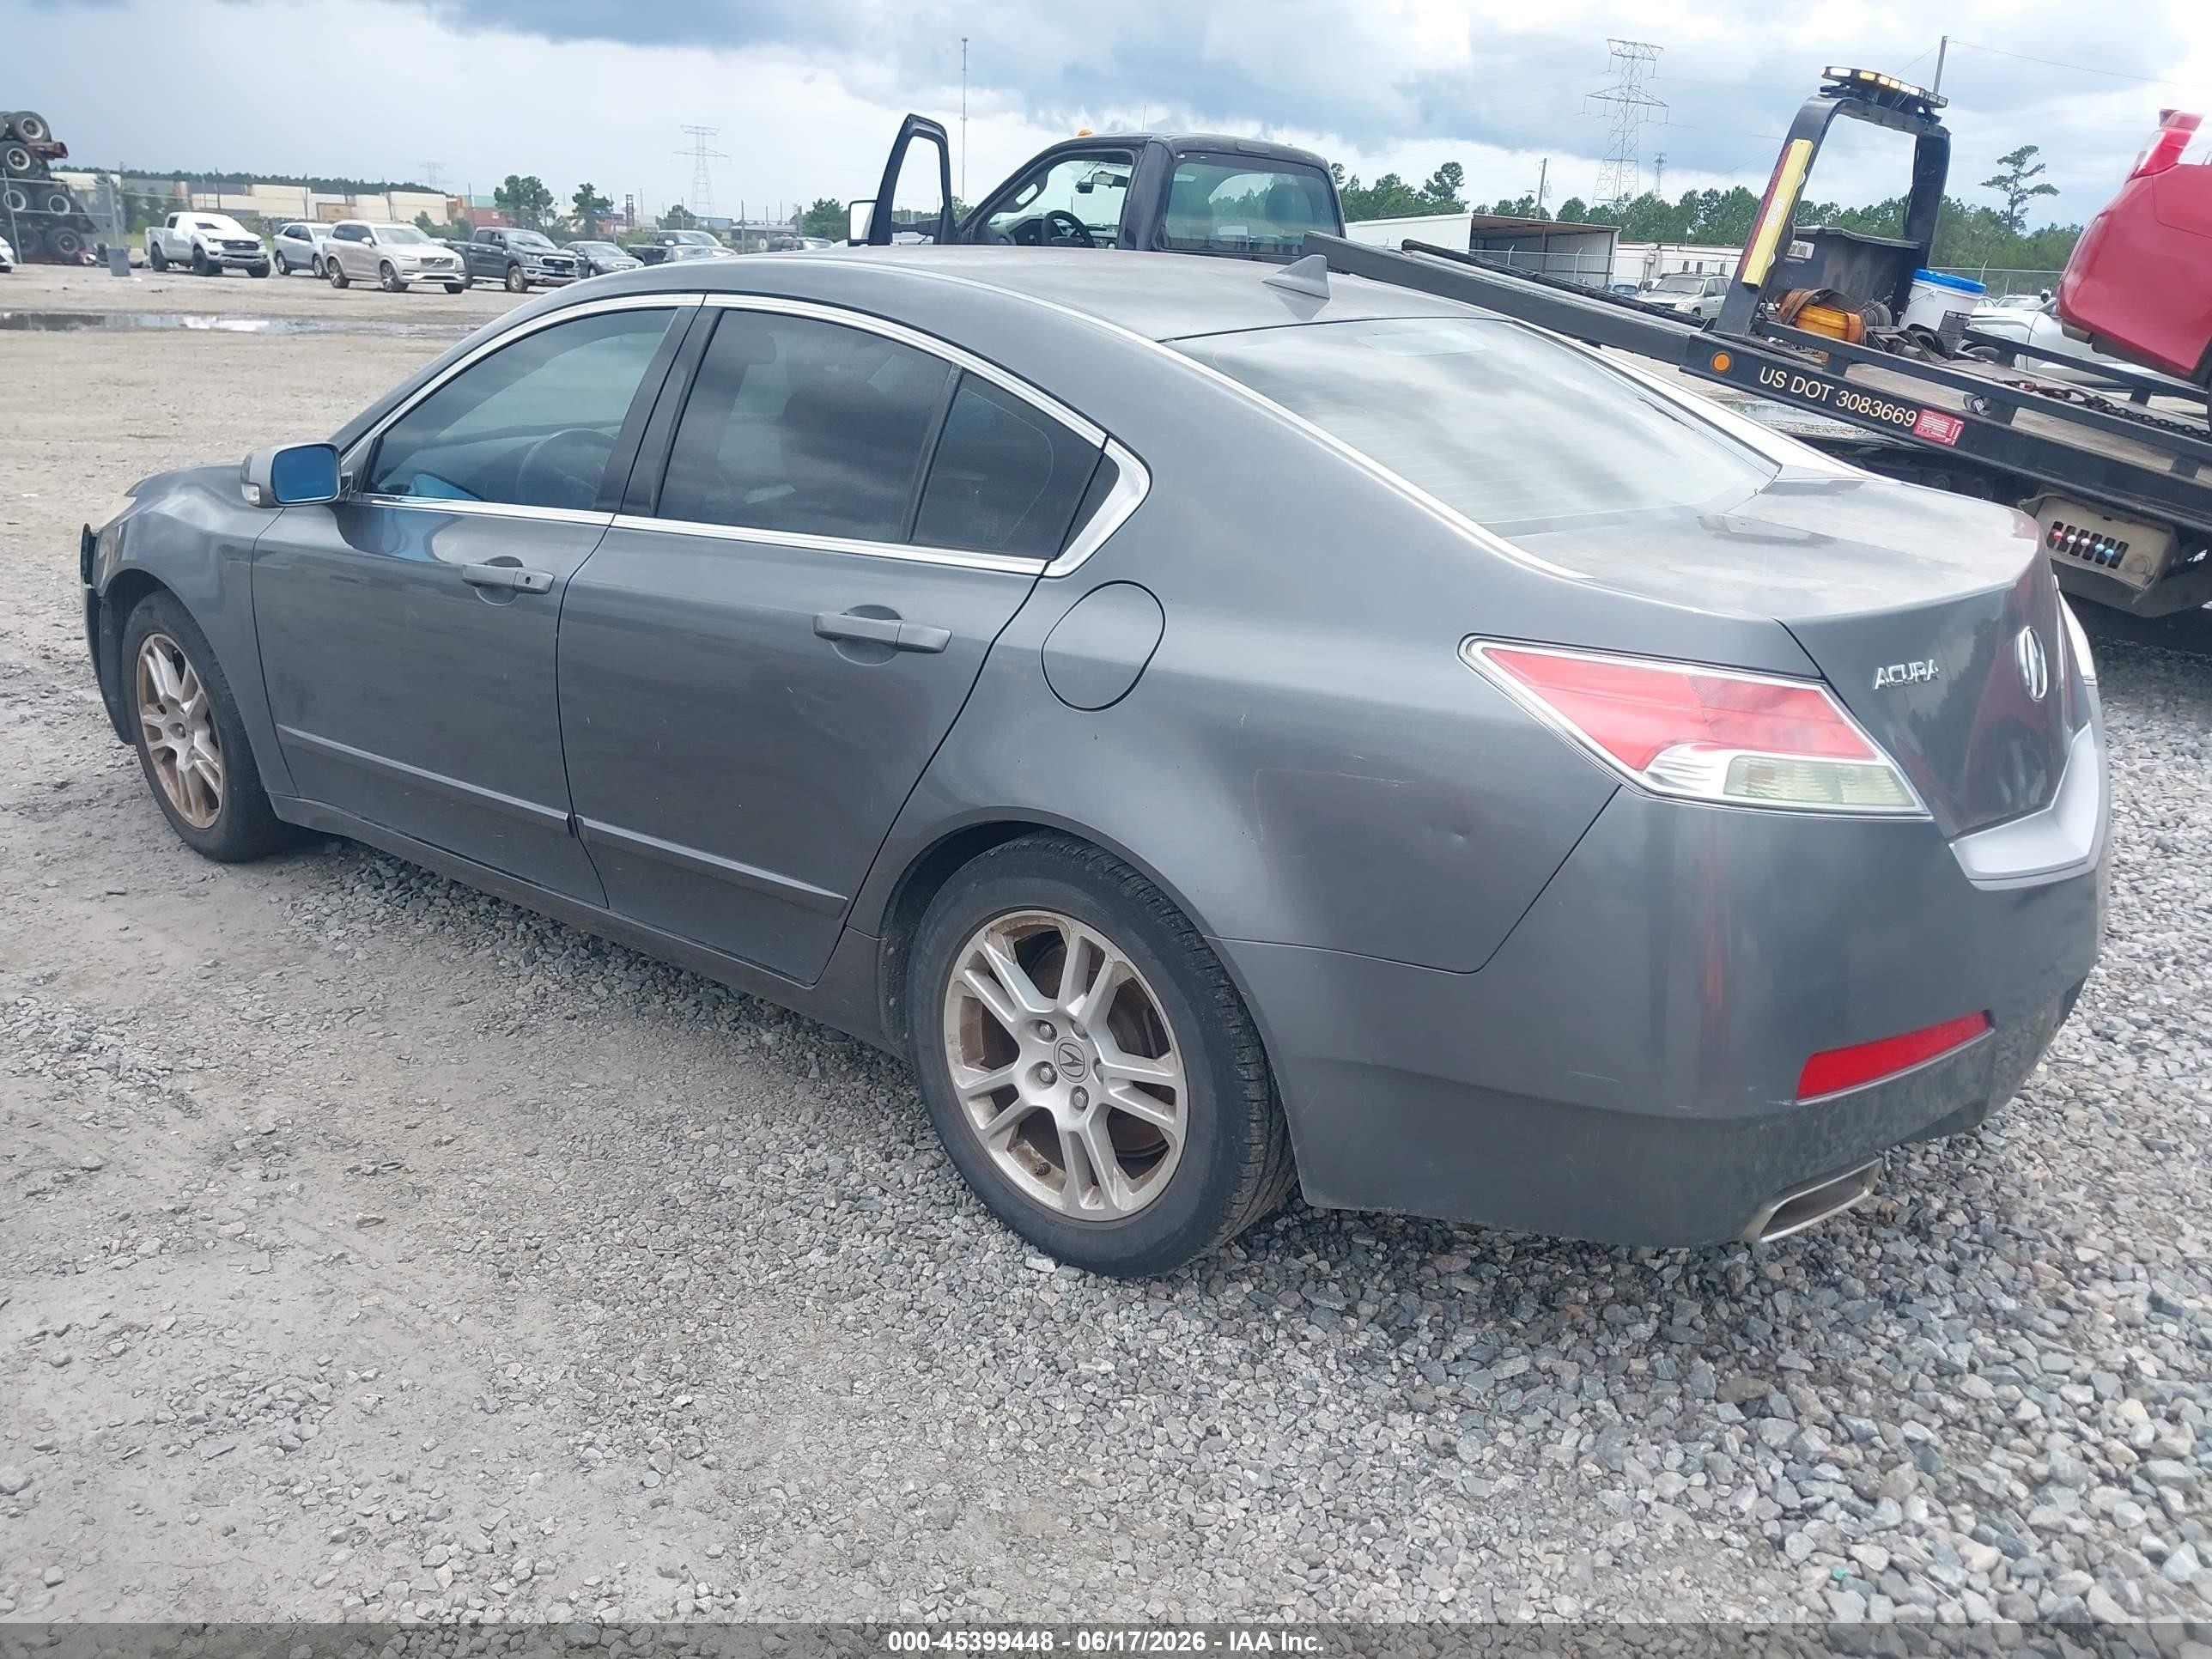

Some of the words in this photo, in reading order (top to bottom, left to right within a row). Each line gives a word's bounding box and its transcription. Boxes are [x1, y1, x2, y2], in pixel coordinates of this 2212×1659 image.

[1759, 366, 1788, 388] US
[1790, 376, 1835, 402] DOT
[1836, 390, 1917, 428] 3083669
[1873, 659, 1939, 690] ACURA
